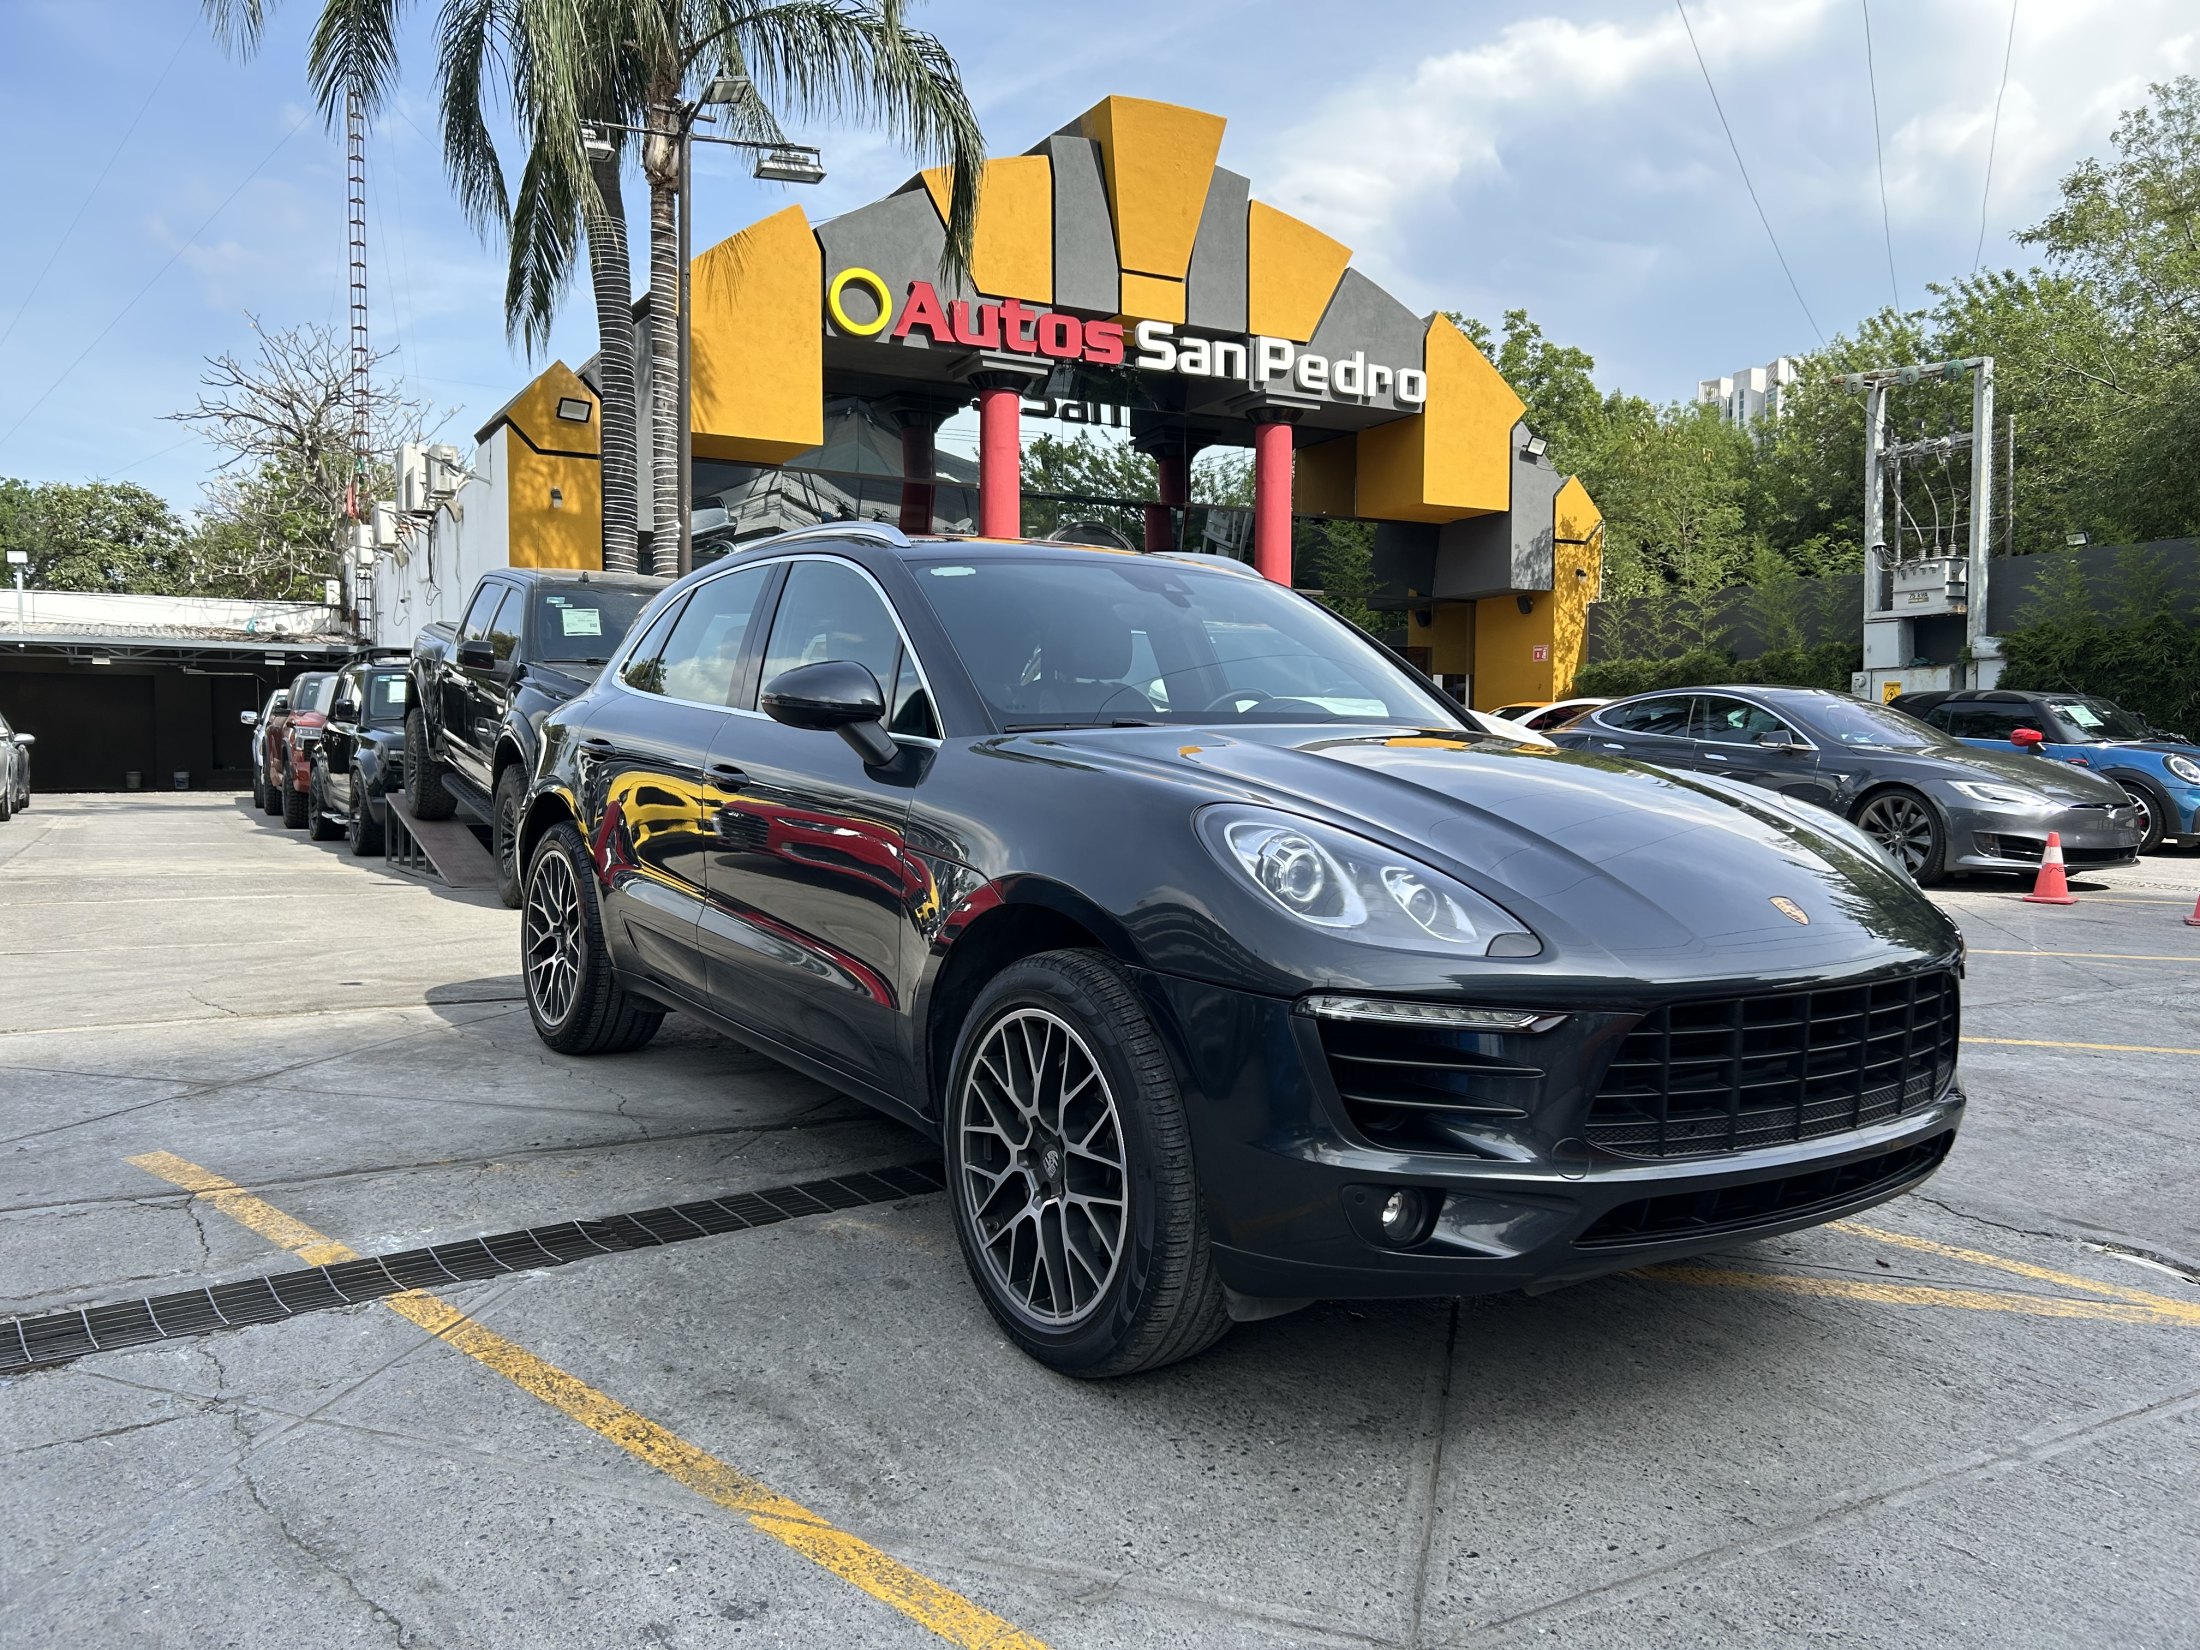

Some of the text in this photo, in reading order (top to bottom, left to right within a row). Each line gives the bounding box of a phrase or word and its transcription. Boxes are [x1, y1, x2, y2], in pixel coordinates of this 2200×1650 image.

[893, 280, 1428, 403] Autos San Pedro
